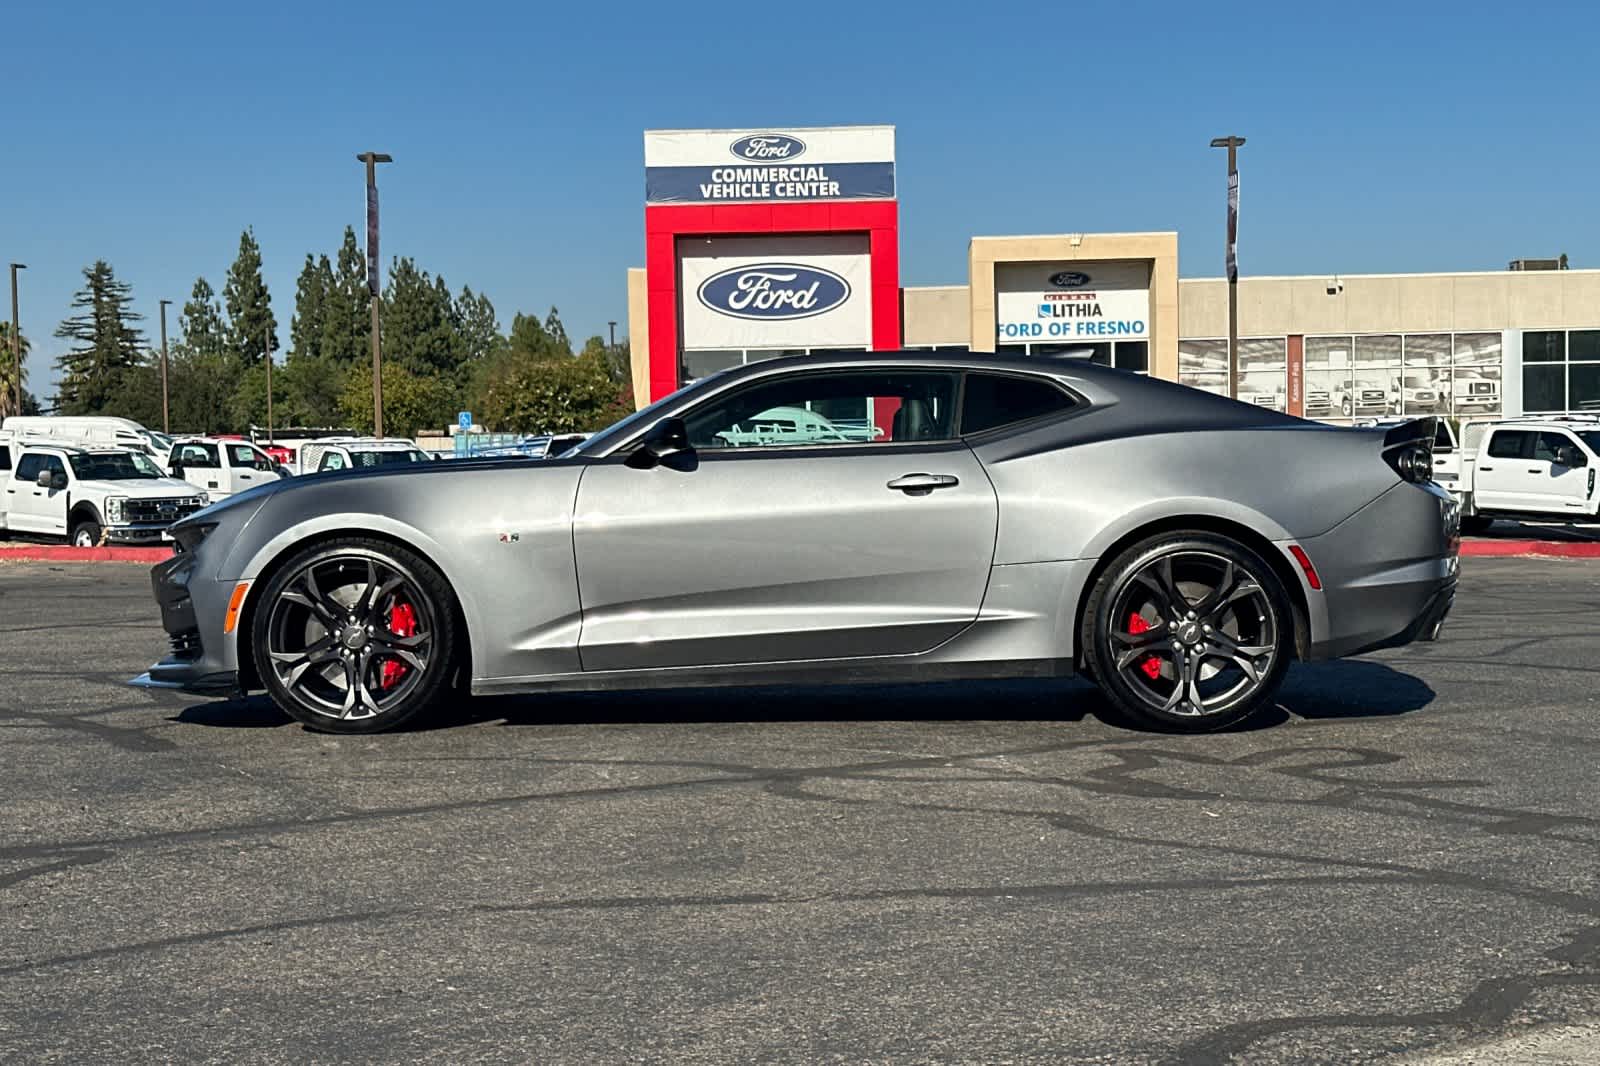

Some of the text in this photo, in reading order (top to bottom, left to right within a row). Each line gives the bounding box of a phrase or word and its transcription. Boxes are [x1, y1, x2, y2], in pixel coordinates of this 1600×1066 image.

[744, 138, 792, 158] Ford
[711, 167, 828, 182] COMMERCIAL
[700, 181, 841, 198] VEHICLE CENTER
[1056, 273, 1084, 286] Ford
[727, 272, 820, 310] Ford
[1052, 303, 1103, 318] LITHIA
[1048, 322, 1071, 336] OF
[1076, 320, 1145, 335] FRESNO
